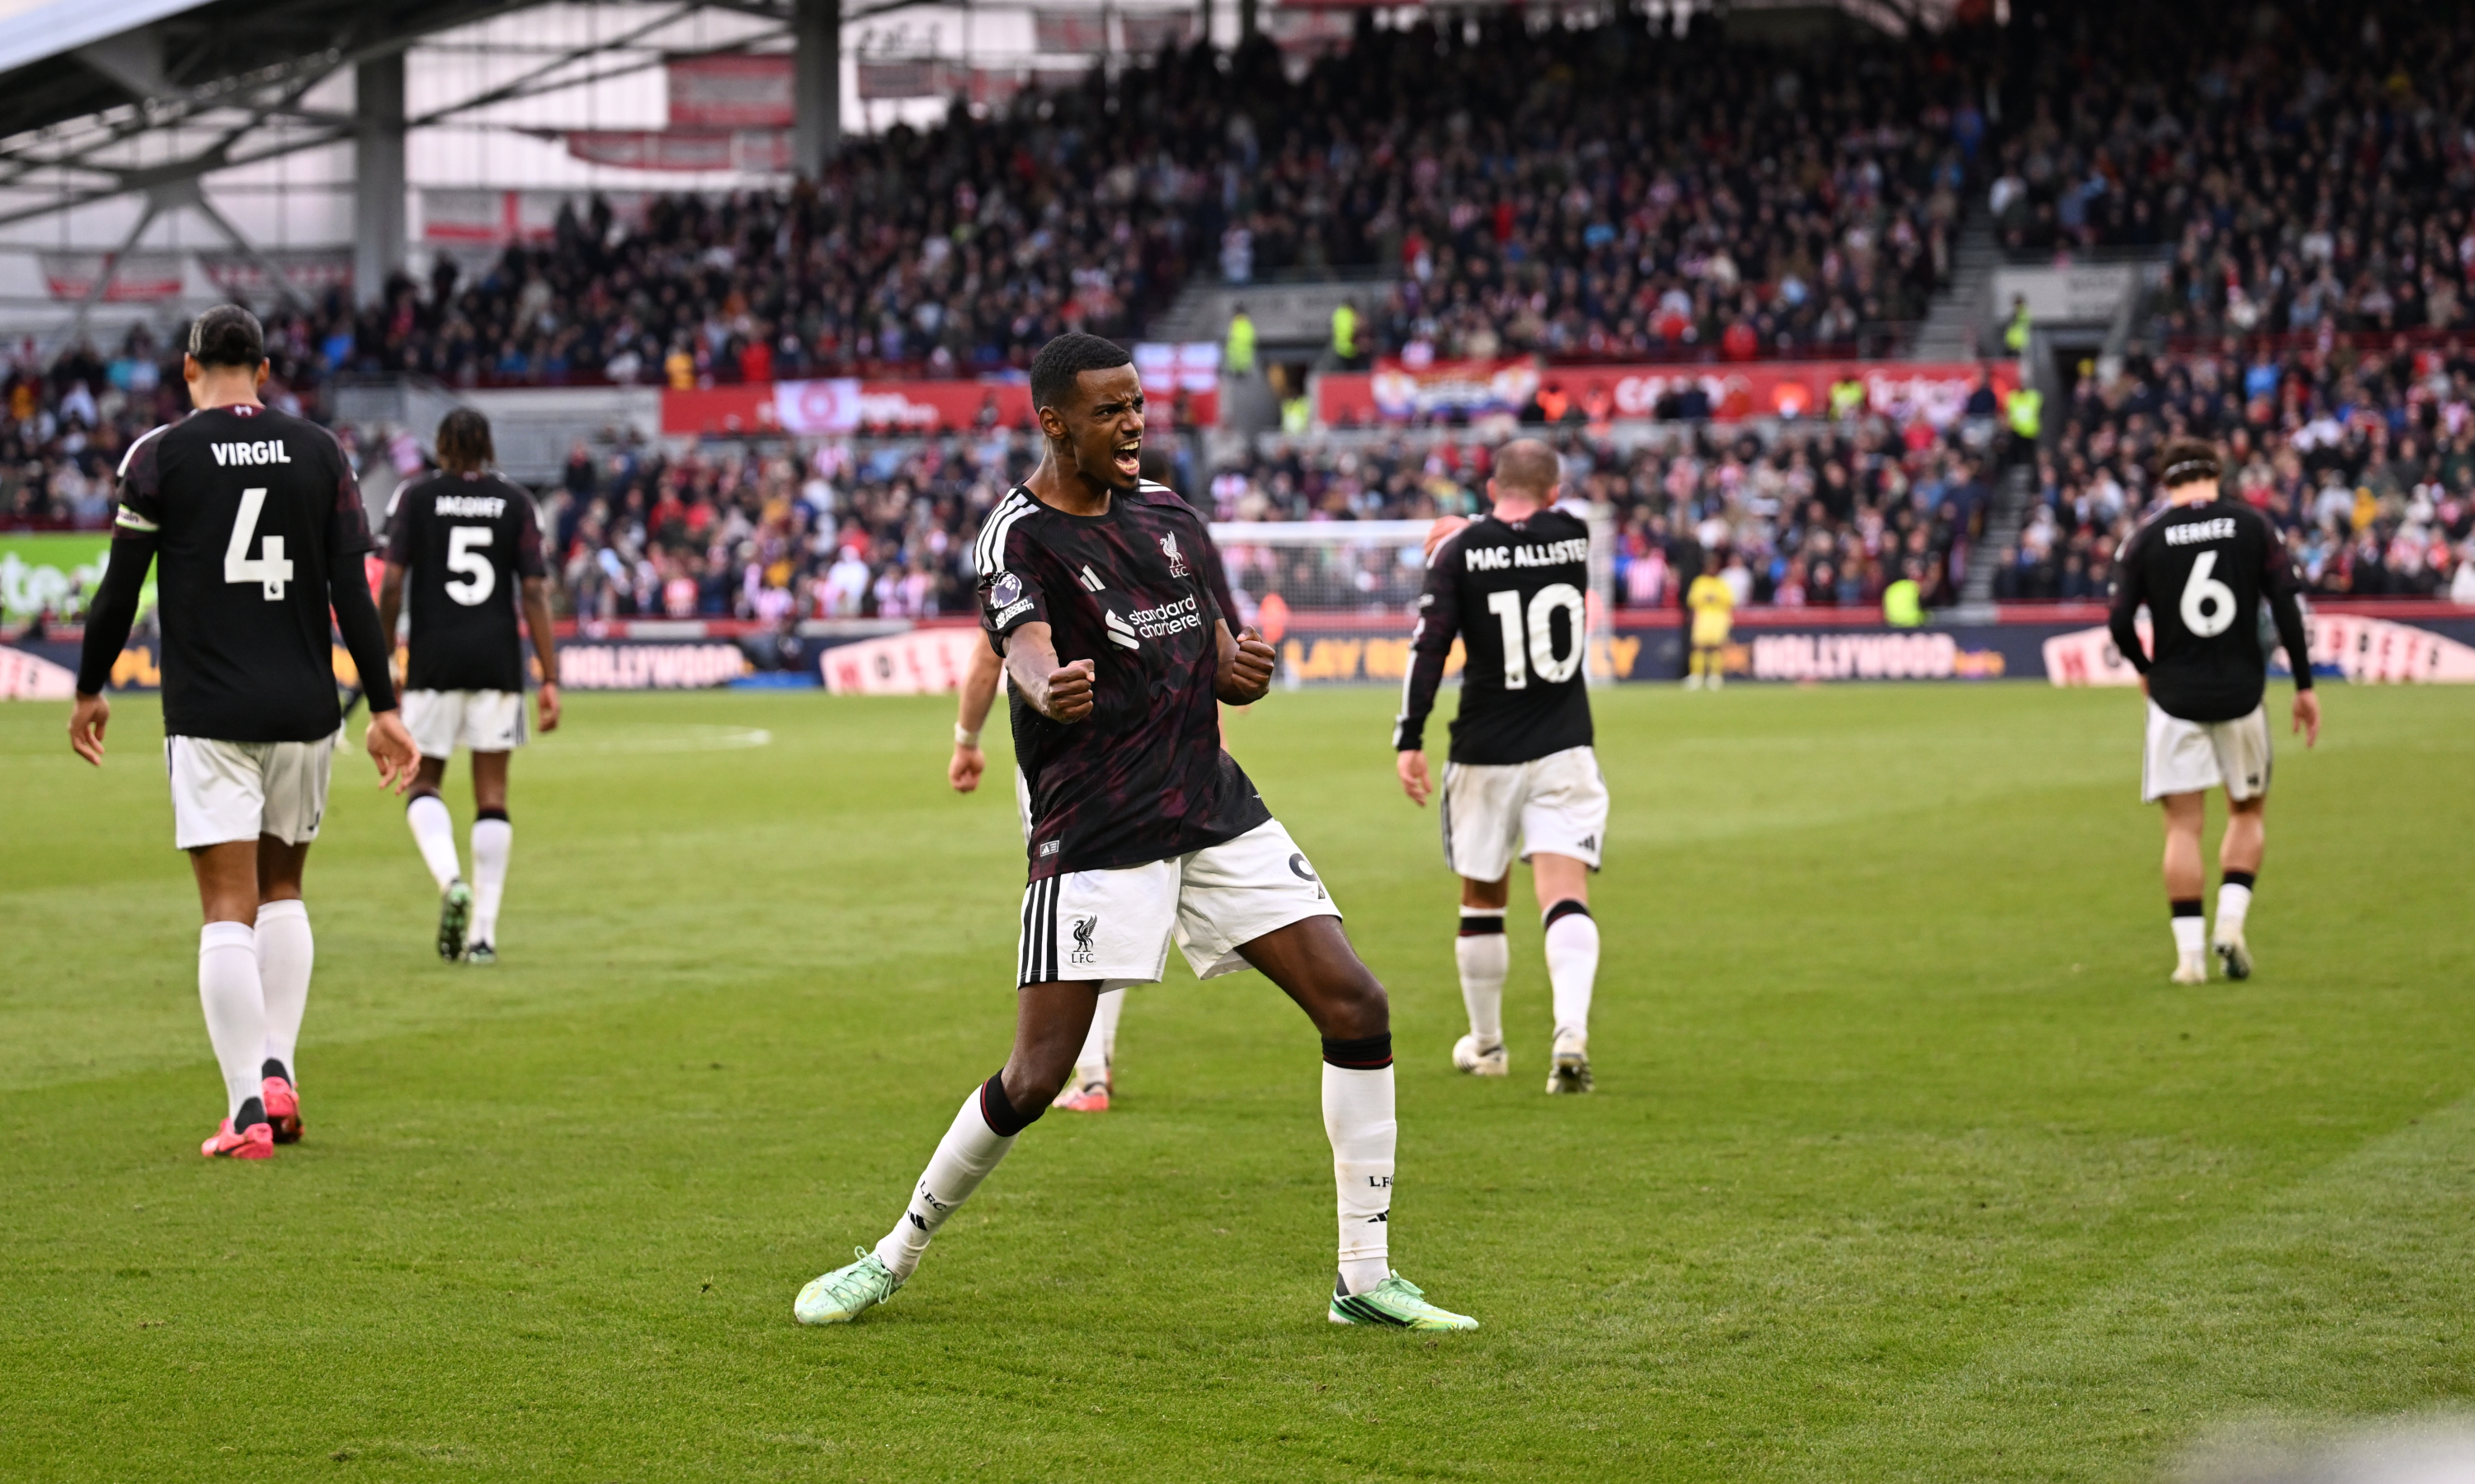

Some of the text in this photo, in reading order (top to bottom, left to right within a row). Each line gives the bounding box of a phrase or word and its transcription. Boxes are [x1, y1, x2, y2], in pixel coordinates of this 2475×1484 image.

[211, 440, 291, 466] VIRGIL
[434, 496, 507, 519] JACQUET
[224, 488, 294, 601] 4
[2165, 517, 2237, 547] KERKEZ
[444, 525, 496, 606] 5
[1465, 546, 1511, 572] MAC
[1004, 598, 1029, 615] room
[2179, 549, 2237, 638] 6
[1005, 602, 1035, 622] racism
[1129, 593, 1197, 625] standard
[1139, 611, 1202, 638] chartered
[1487, 583, 1586, 690] 10
[1282, 637, 1362, 681] LAY
[1753, 632, 1956, 680] HOLLYWOOD
[1071, 954, 1096, 963] L.F.C.
